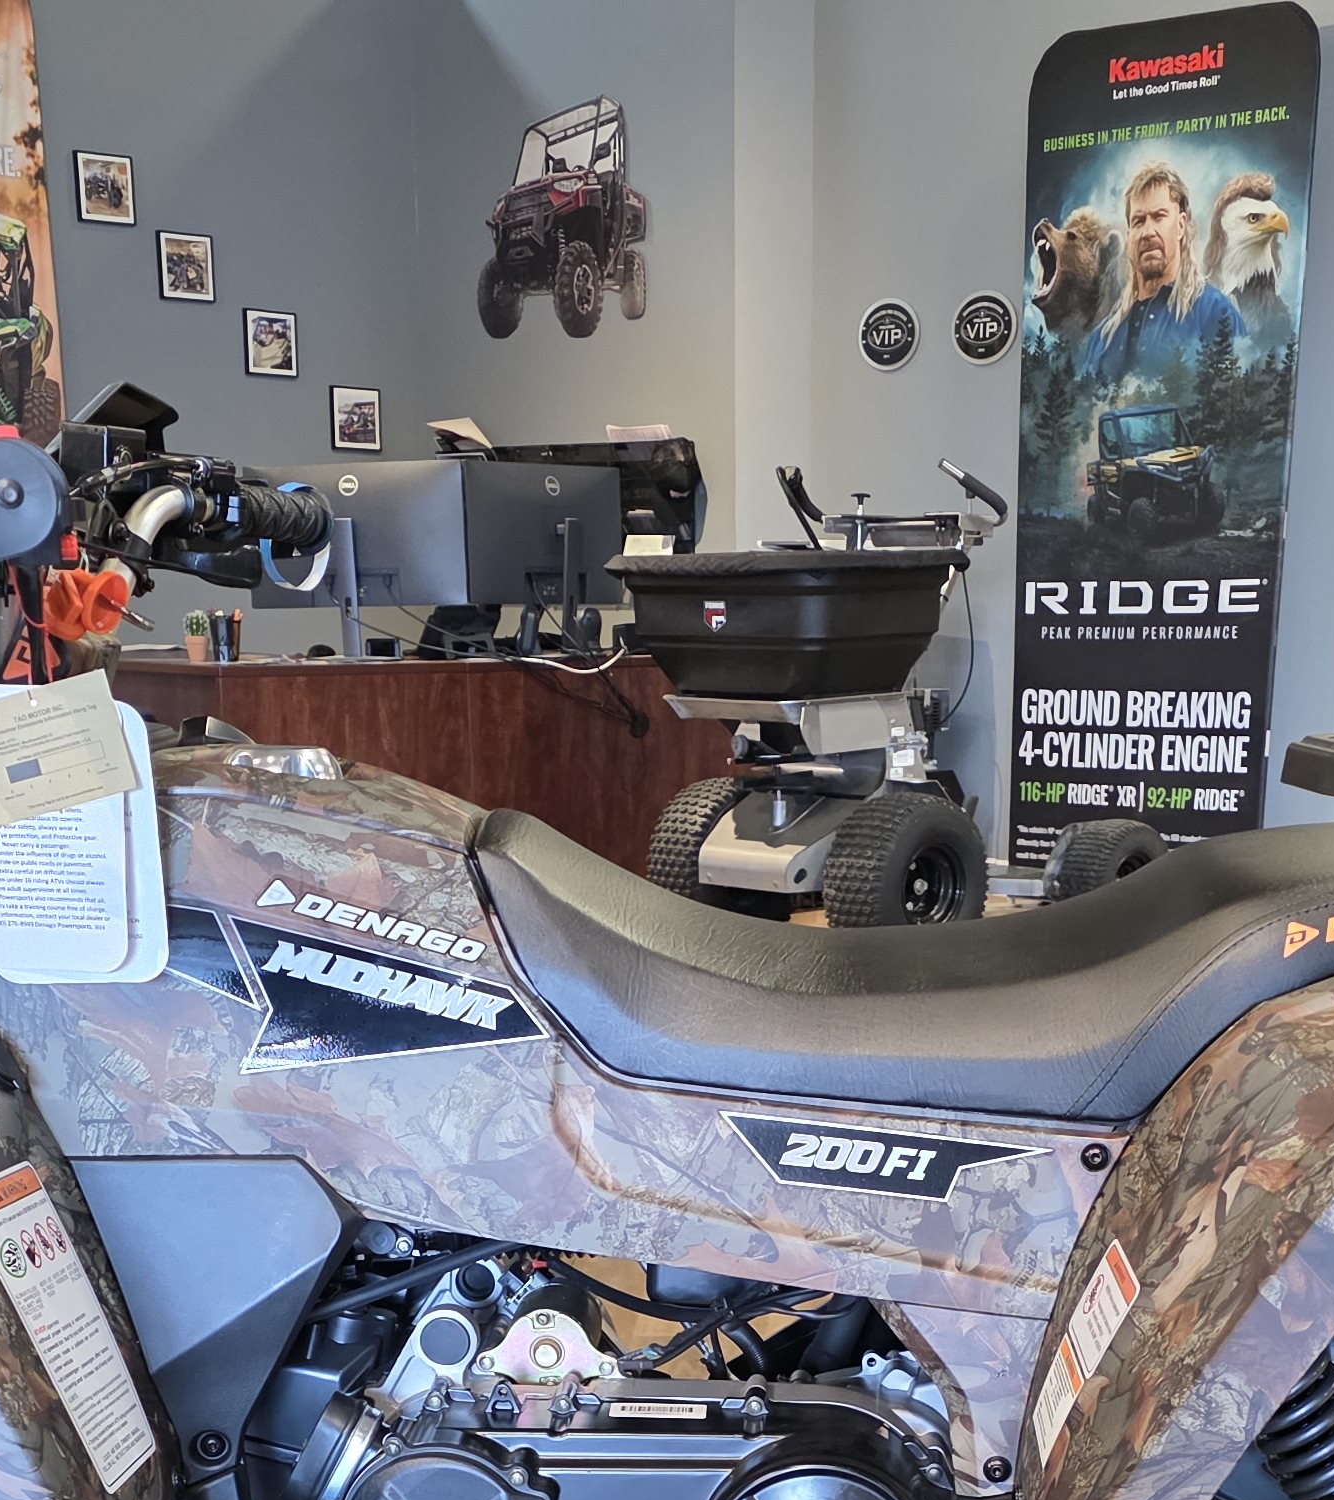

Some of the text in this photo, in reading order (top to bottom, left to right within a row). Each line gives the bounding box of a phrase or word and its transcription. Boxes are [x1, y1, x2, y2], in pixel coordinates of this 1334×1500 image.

[1109, 43, 1225, 83] Kawasaki
[1113, 89, 1127, 100] Let
[1130, 87, 1143, 97] the
[1145, 83, 1169, 95] Good
[1170, 80, 1197, 92] Times
[1043, 106, 1290, 152] BUSINESS IN THE FRONT. PARTY IN THE BACK.
[872, 329, 902, 345] VIP
[967, 322, 998, 339] VIP
[1041, 625, 1239, 640] PEAK PREMIUM PERFORMANCE
[28, 707, 51, 719] MOTOR
[1021, 688, 1252, 729] GROUND BREAKING
[1019, 731, 1250, 773] 4-CYLINDER ENGINE
[1019, 781, 1065, 803] 116-HP
[1117, 785, 1136, 808] XR
[1147, 787, 1192, 809] 92-HP
[293, 892, 487, 962] DENAGO
[260, 939, 515, 1031] MUDHAWK
[779, 1133, 936, 1181] 200FI
